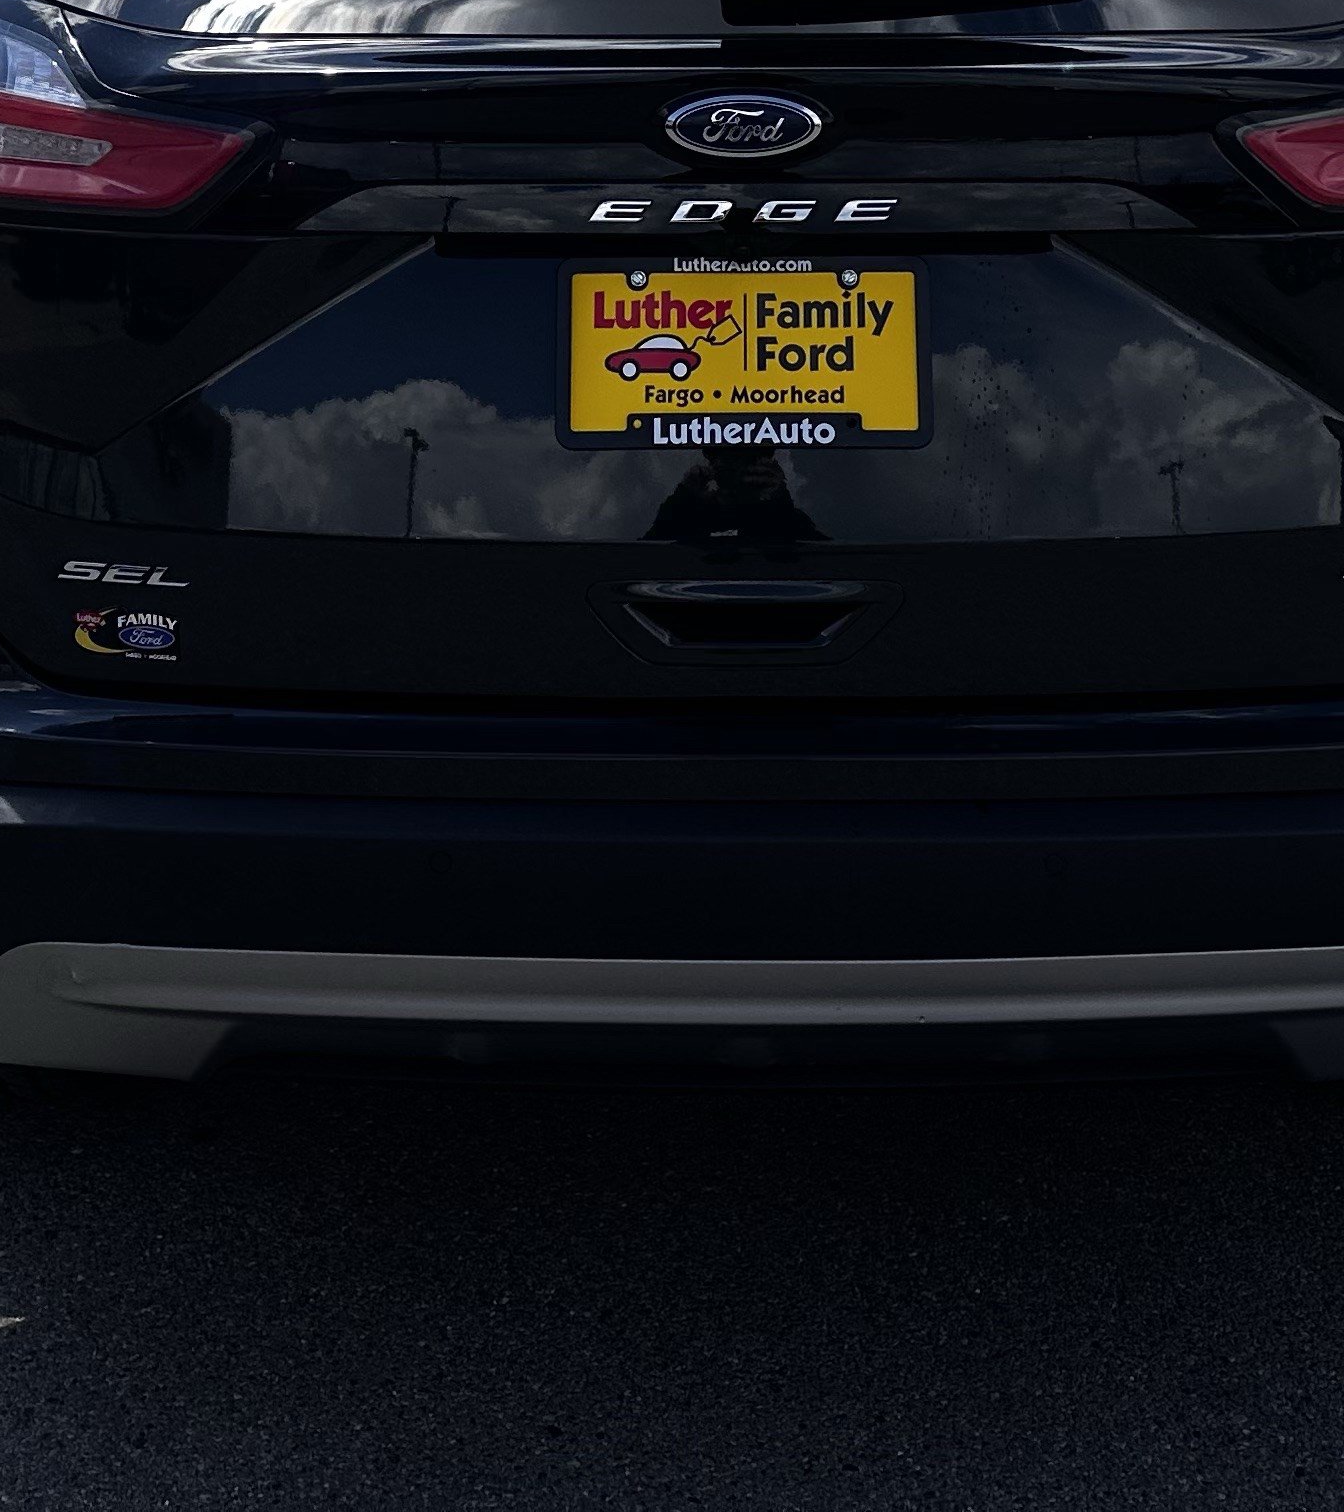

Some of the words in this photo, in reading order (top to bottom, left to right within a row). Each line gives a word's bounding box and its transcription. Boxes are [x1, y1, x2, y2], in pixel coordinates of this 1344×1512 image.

[702, 108, 786, 143] Ford
[588, 199, 898, 223] EDGE
[672, 256, 813, 273] LutherAuto.com
[593, 289, 734, 330] Luther
[756, 289, 895, 337] Family
[756, 335, 855, 372] Ford
[644, 384, 705, 408] Fargo
[730, 384, 845, 405] Moorhead
[652, 416, 836, 446] LutherAuto
[57, 560, 190, 587] SEL
[76, 612, 102, 624] Luther
[117, 612, 178, 630] FAMILY
[129, 629, 164, 646] Ford
